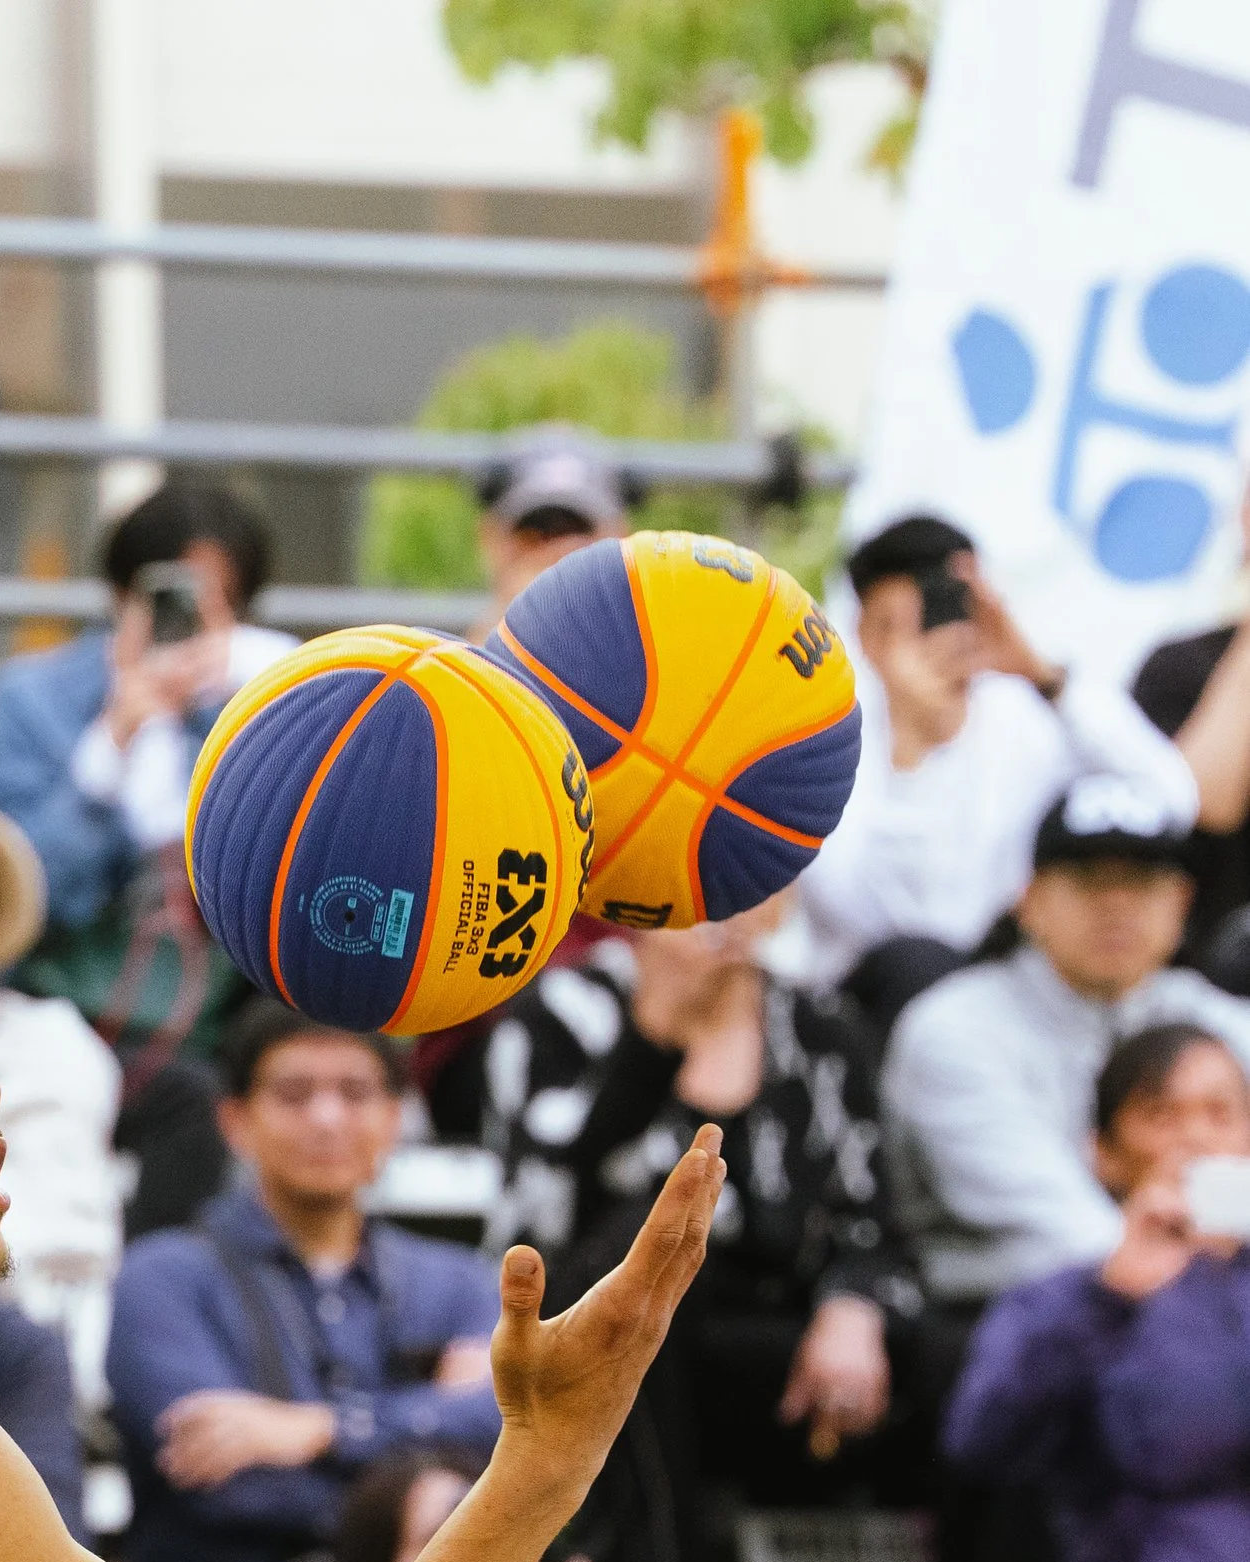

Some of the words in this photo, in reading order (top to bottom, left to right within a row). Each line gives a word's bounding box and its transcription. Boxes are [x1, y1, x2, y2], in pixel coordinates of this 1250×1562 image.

[455, 860, 475, 938] OFFICIAL
[473, 882, 491, 923] FIBA
[442, 941, 464, 975] BALL
